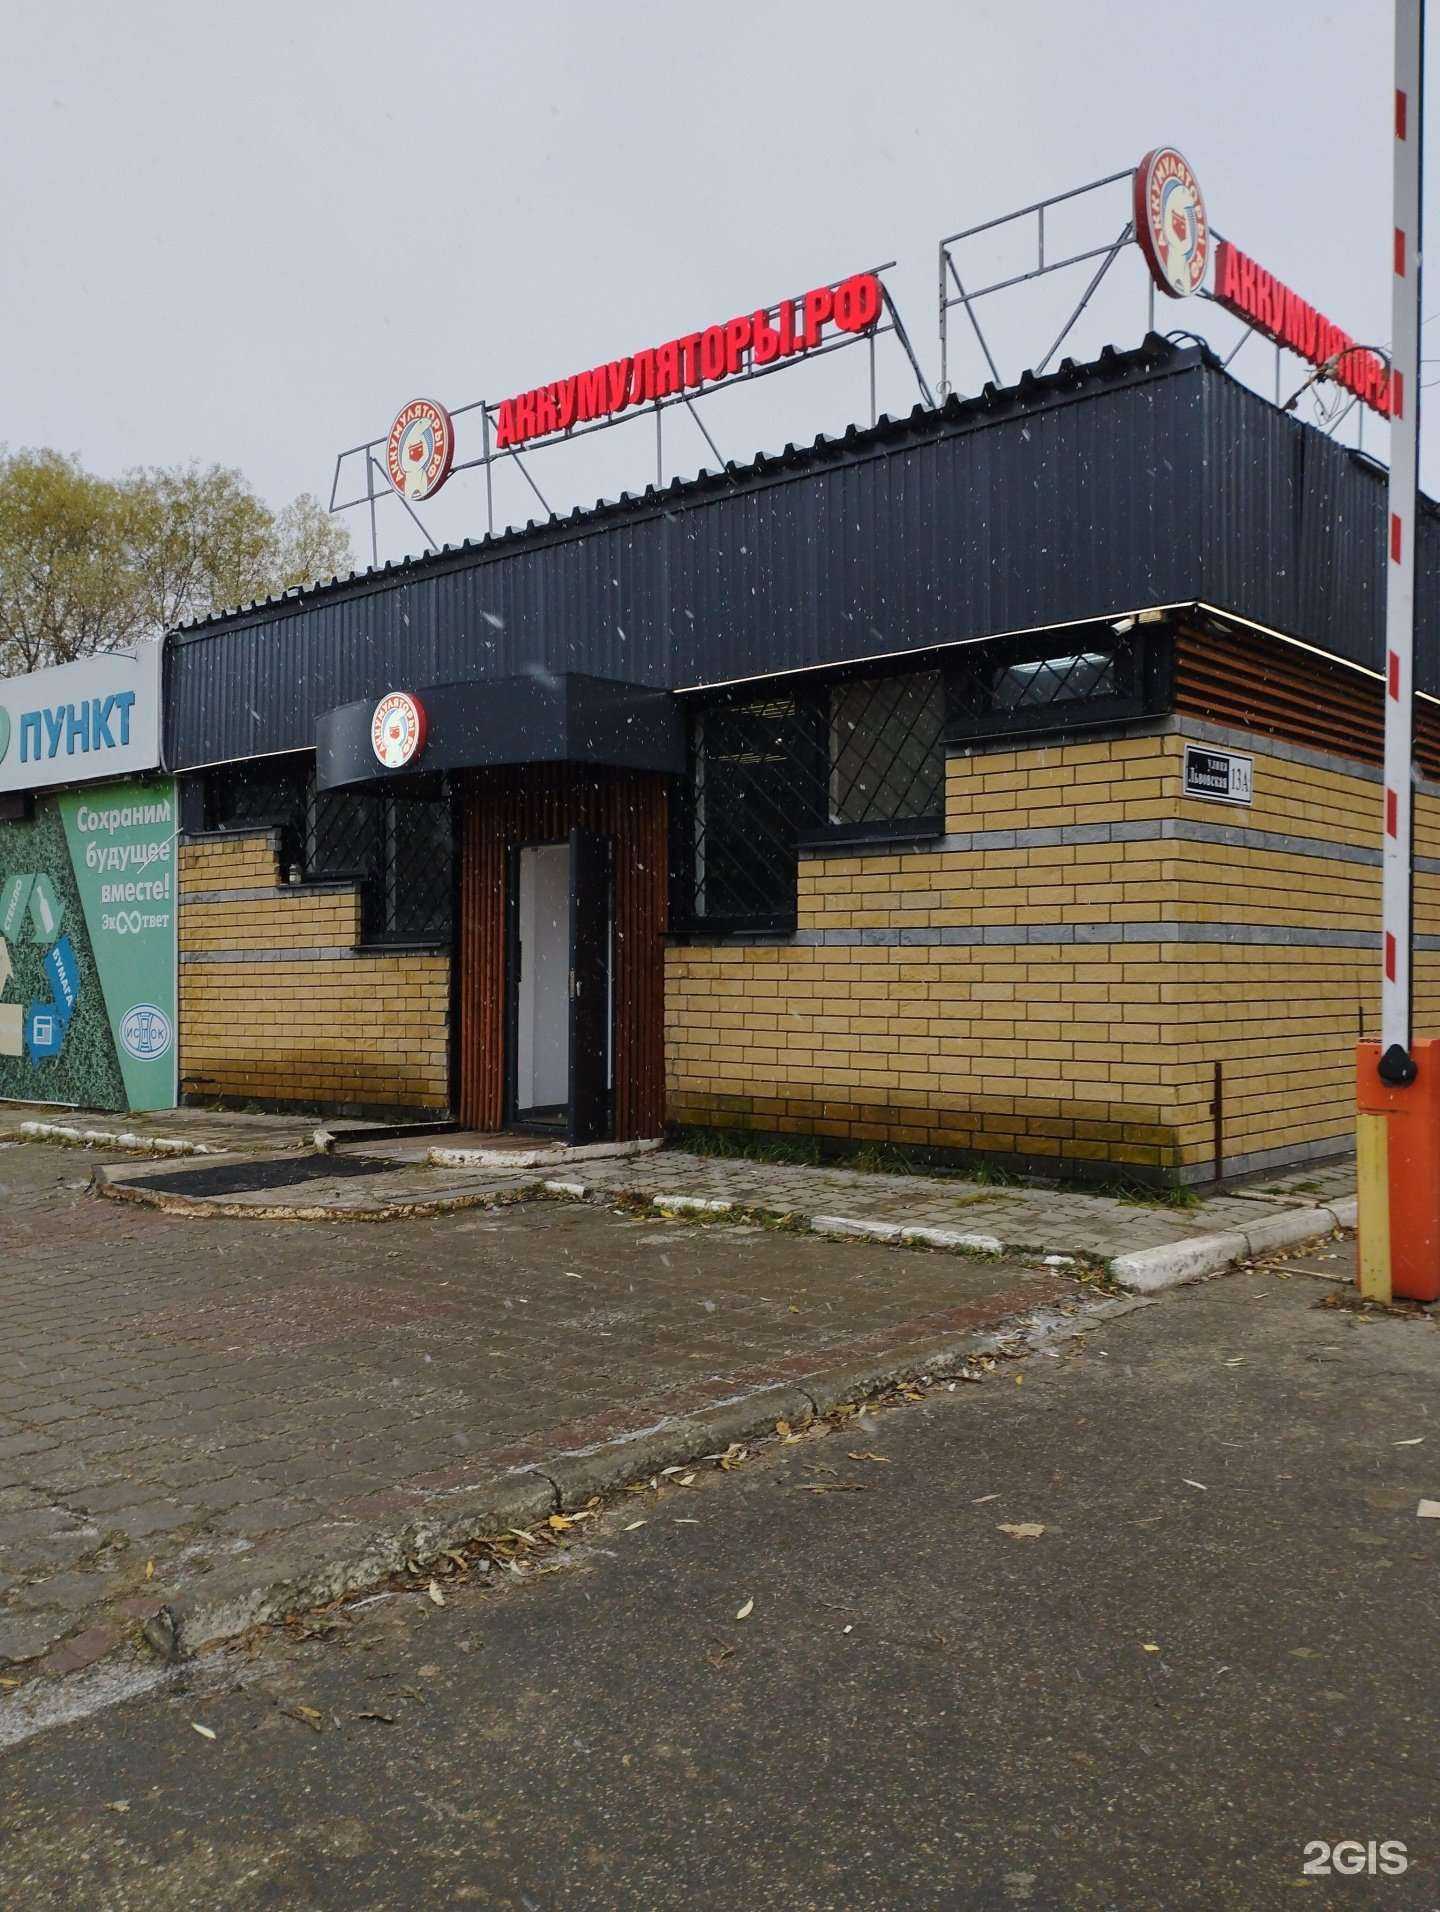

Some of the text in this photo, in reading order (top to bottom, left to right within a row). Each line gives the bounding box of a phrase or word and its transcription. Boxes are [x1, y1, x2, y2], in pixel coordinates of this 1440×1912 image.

[496, 273, 884, 449] АККУМУЛЯТОРЫ.РФ
[389, 404, 443, 482] АККУМУЛЯТОРЫ
[19, 690, 136, 763] ПУНКТ
[77, 802, 171, 836] Сохраним
[86, 841, 171, 874] будущее
[4, 879, 22, 931] СТЕКЛО
[101, 873, 170, 903] вместе!
[51, 948, 76, 1008] БУМАГА
